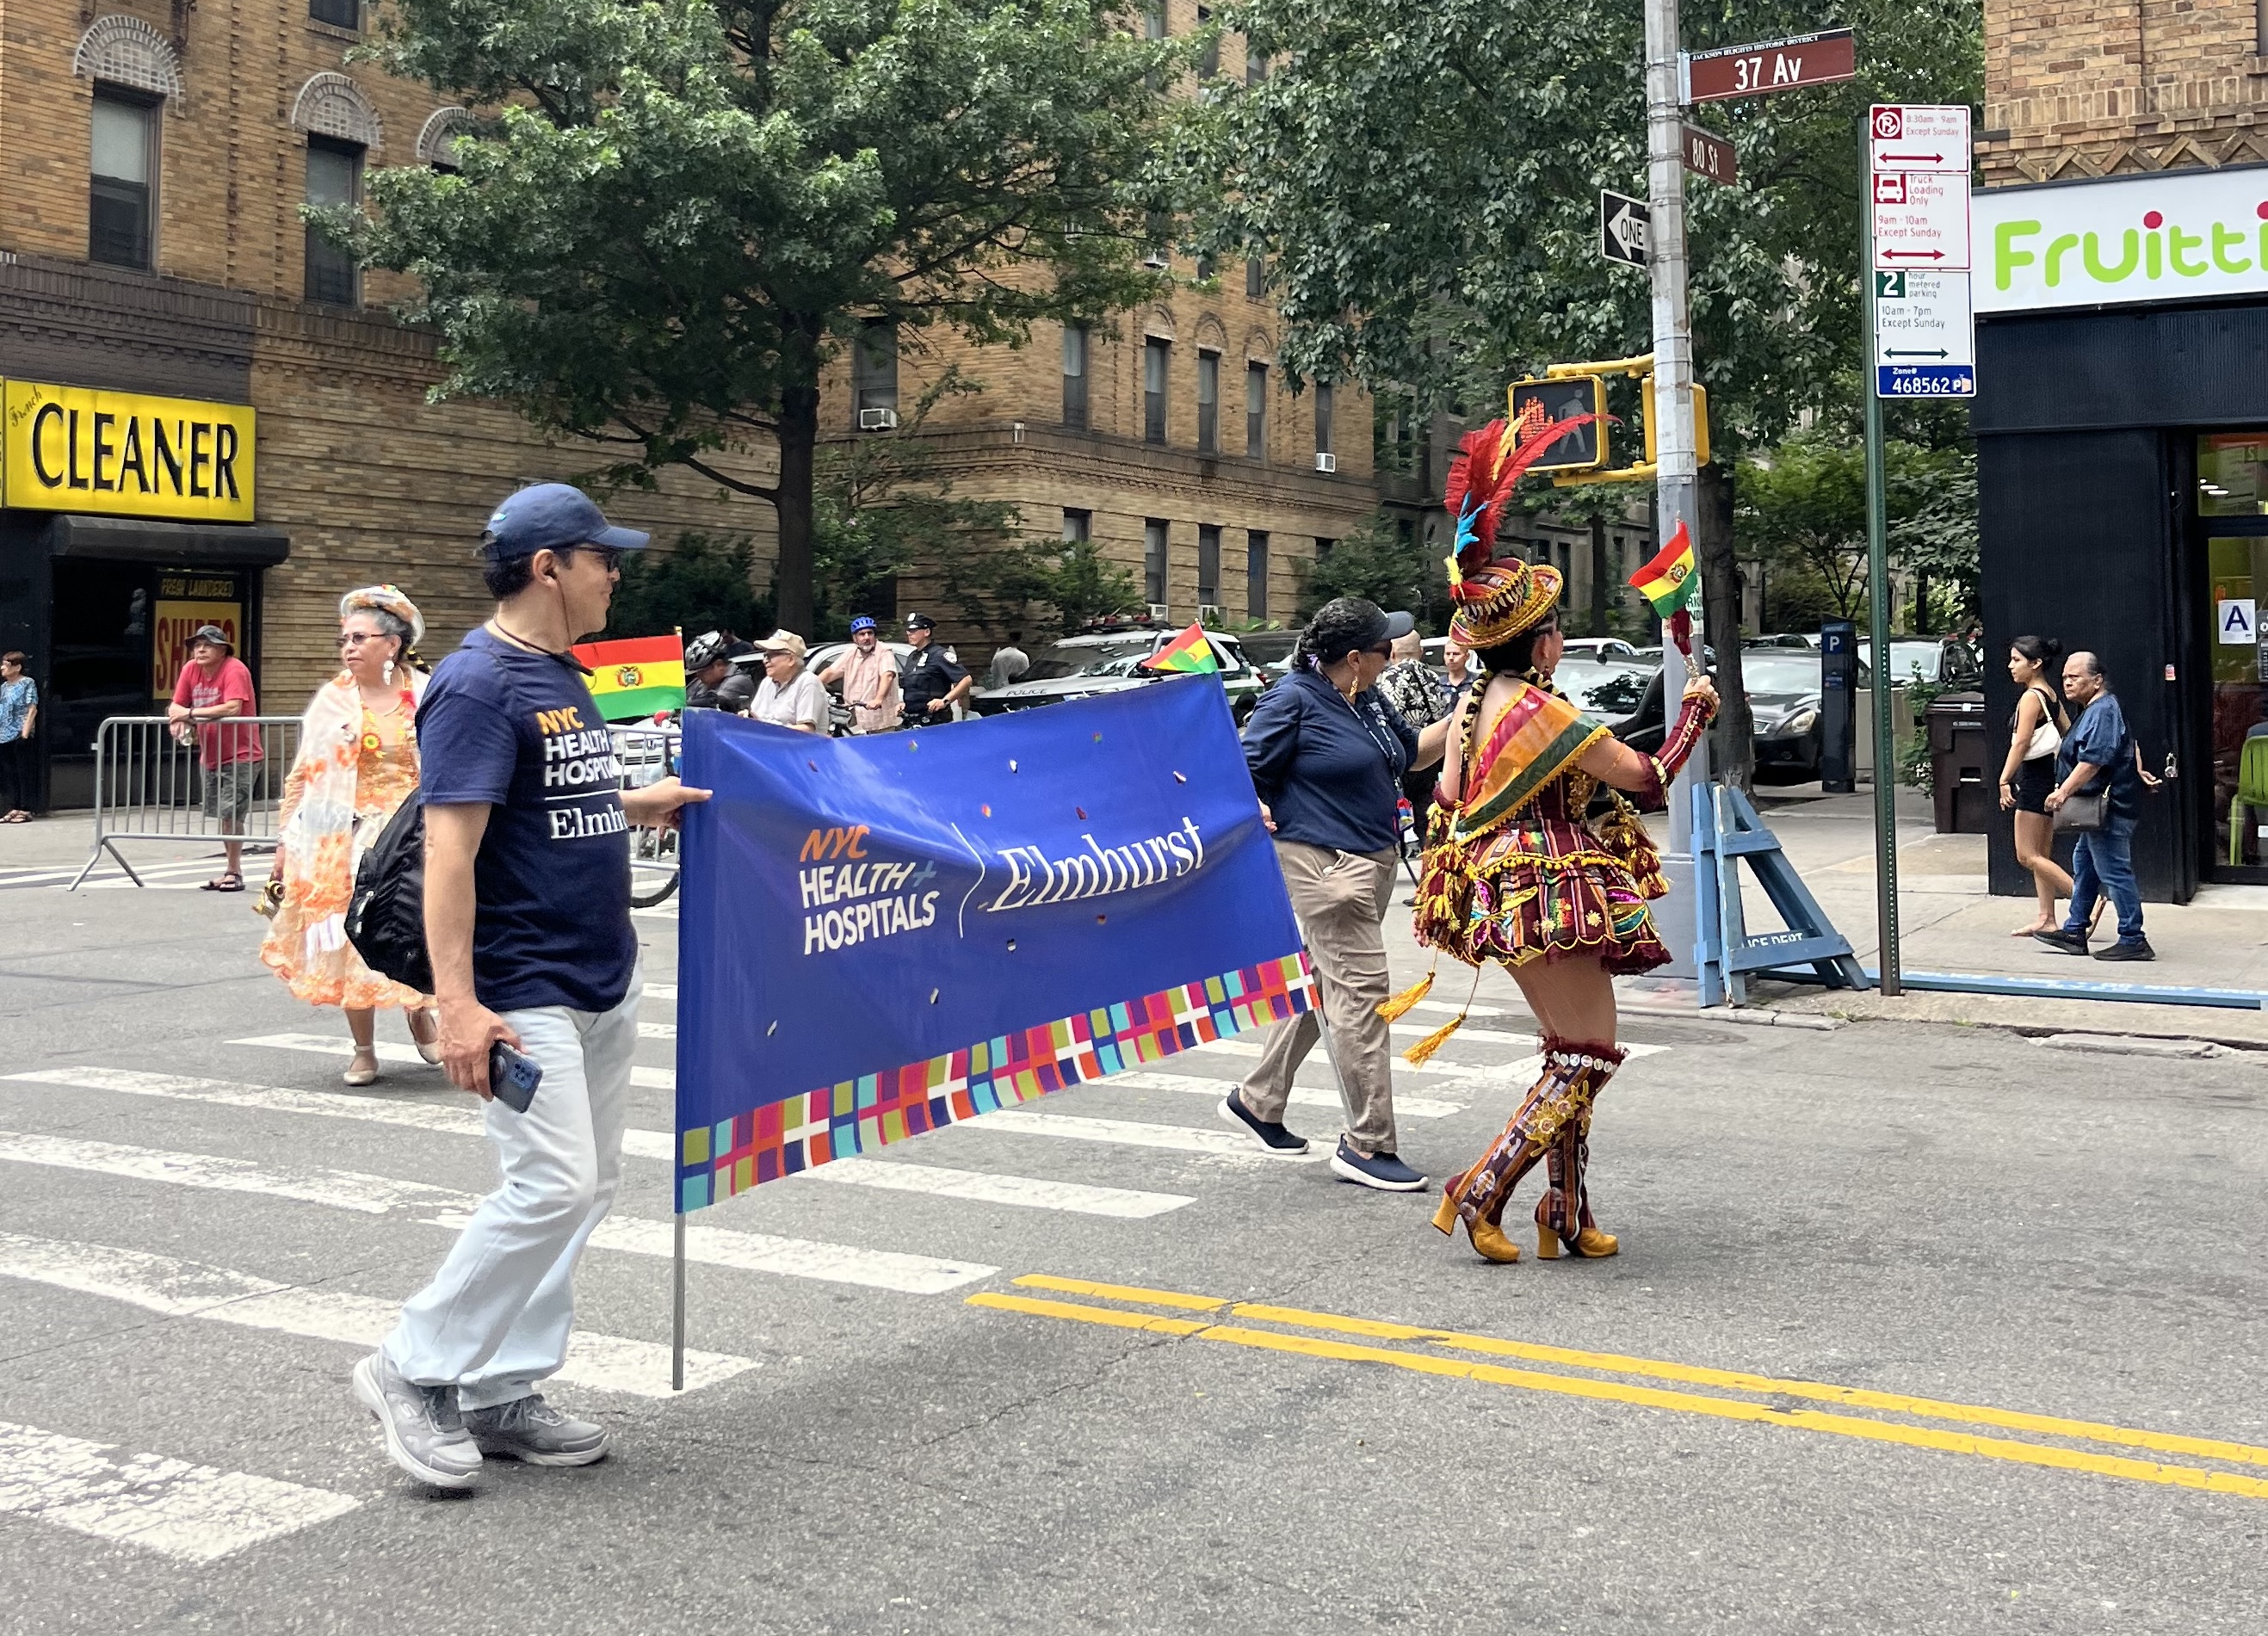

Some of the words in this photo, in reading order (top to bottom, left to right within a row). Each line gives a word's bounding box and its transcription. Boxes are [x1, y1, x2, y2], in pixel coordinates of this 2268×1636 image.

[1692, 50, 1722, 62] JACKSON
[1753, 40, 1786, 52] HISTORIC
[1786, 35, 1819, 46] DISTRICT
[1734, 57, 1763, 91] 37
[1772, 52, 1802, 85] Av
[1906, 114, 1934, 123] 8:30am
[1906, 127, 1931, 136] Except
[1932, 128, 1959, 138] Sunday
[1692, 138, 1705, 170] 80
[1708, 144, 1720, 176] St
[1909, 175, 1934, 184] Truck
[1909, 186, 1944, 196] Loading
[1909, 196, 1929, 207] Only
[1878, 215, 1897, 225] 9am
[1905, 216, 1928, 225] 10am
[1620, 218, 1644, 247] ONE
[1878, 227, 1907, 238] Except
[1910, 228, 1942, 238] Sunday
[1994, 201, 2268, 291] Fruitti
[1882, 271, 1899, 296] 2
[1908, 289, 1937, 299] parking
[1882, 306, 1905, 316] 10am
[1913, 306, 1931, 318] 7pm
[1882, 318, 1912, 329] Except
[1913, 318, 1946, 330] Sunday
[1892, 377, 1950, 394] 468562
[32, 402, 241, 503] CLEANER
[2224, 605, 2249, 632] A
[1829, 635, 1840, 651] P
[1005, 688, 1047, 698] POLICE
[536, 707, 584, 735] NYC
[799, 824, 870, 862] NYC
[986, 816, 1206, 913] Elmhurst
[803, 891, 940, 955] HOSPITALS
